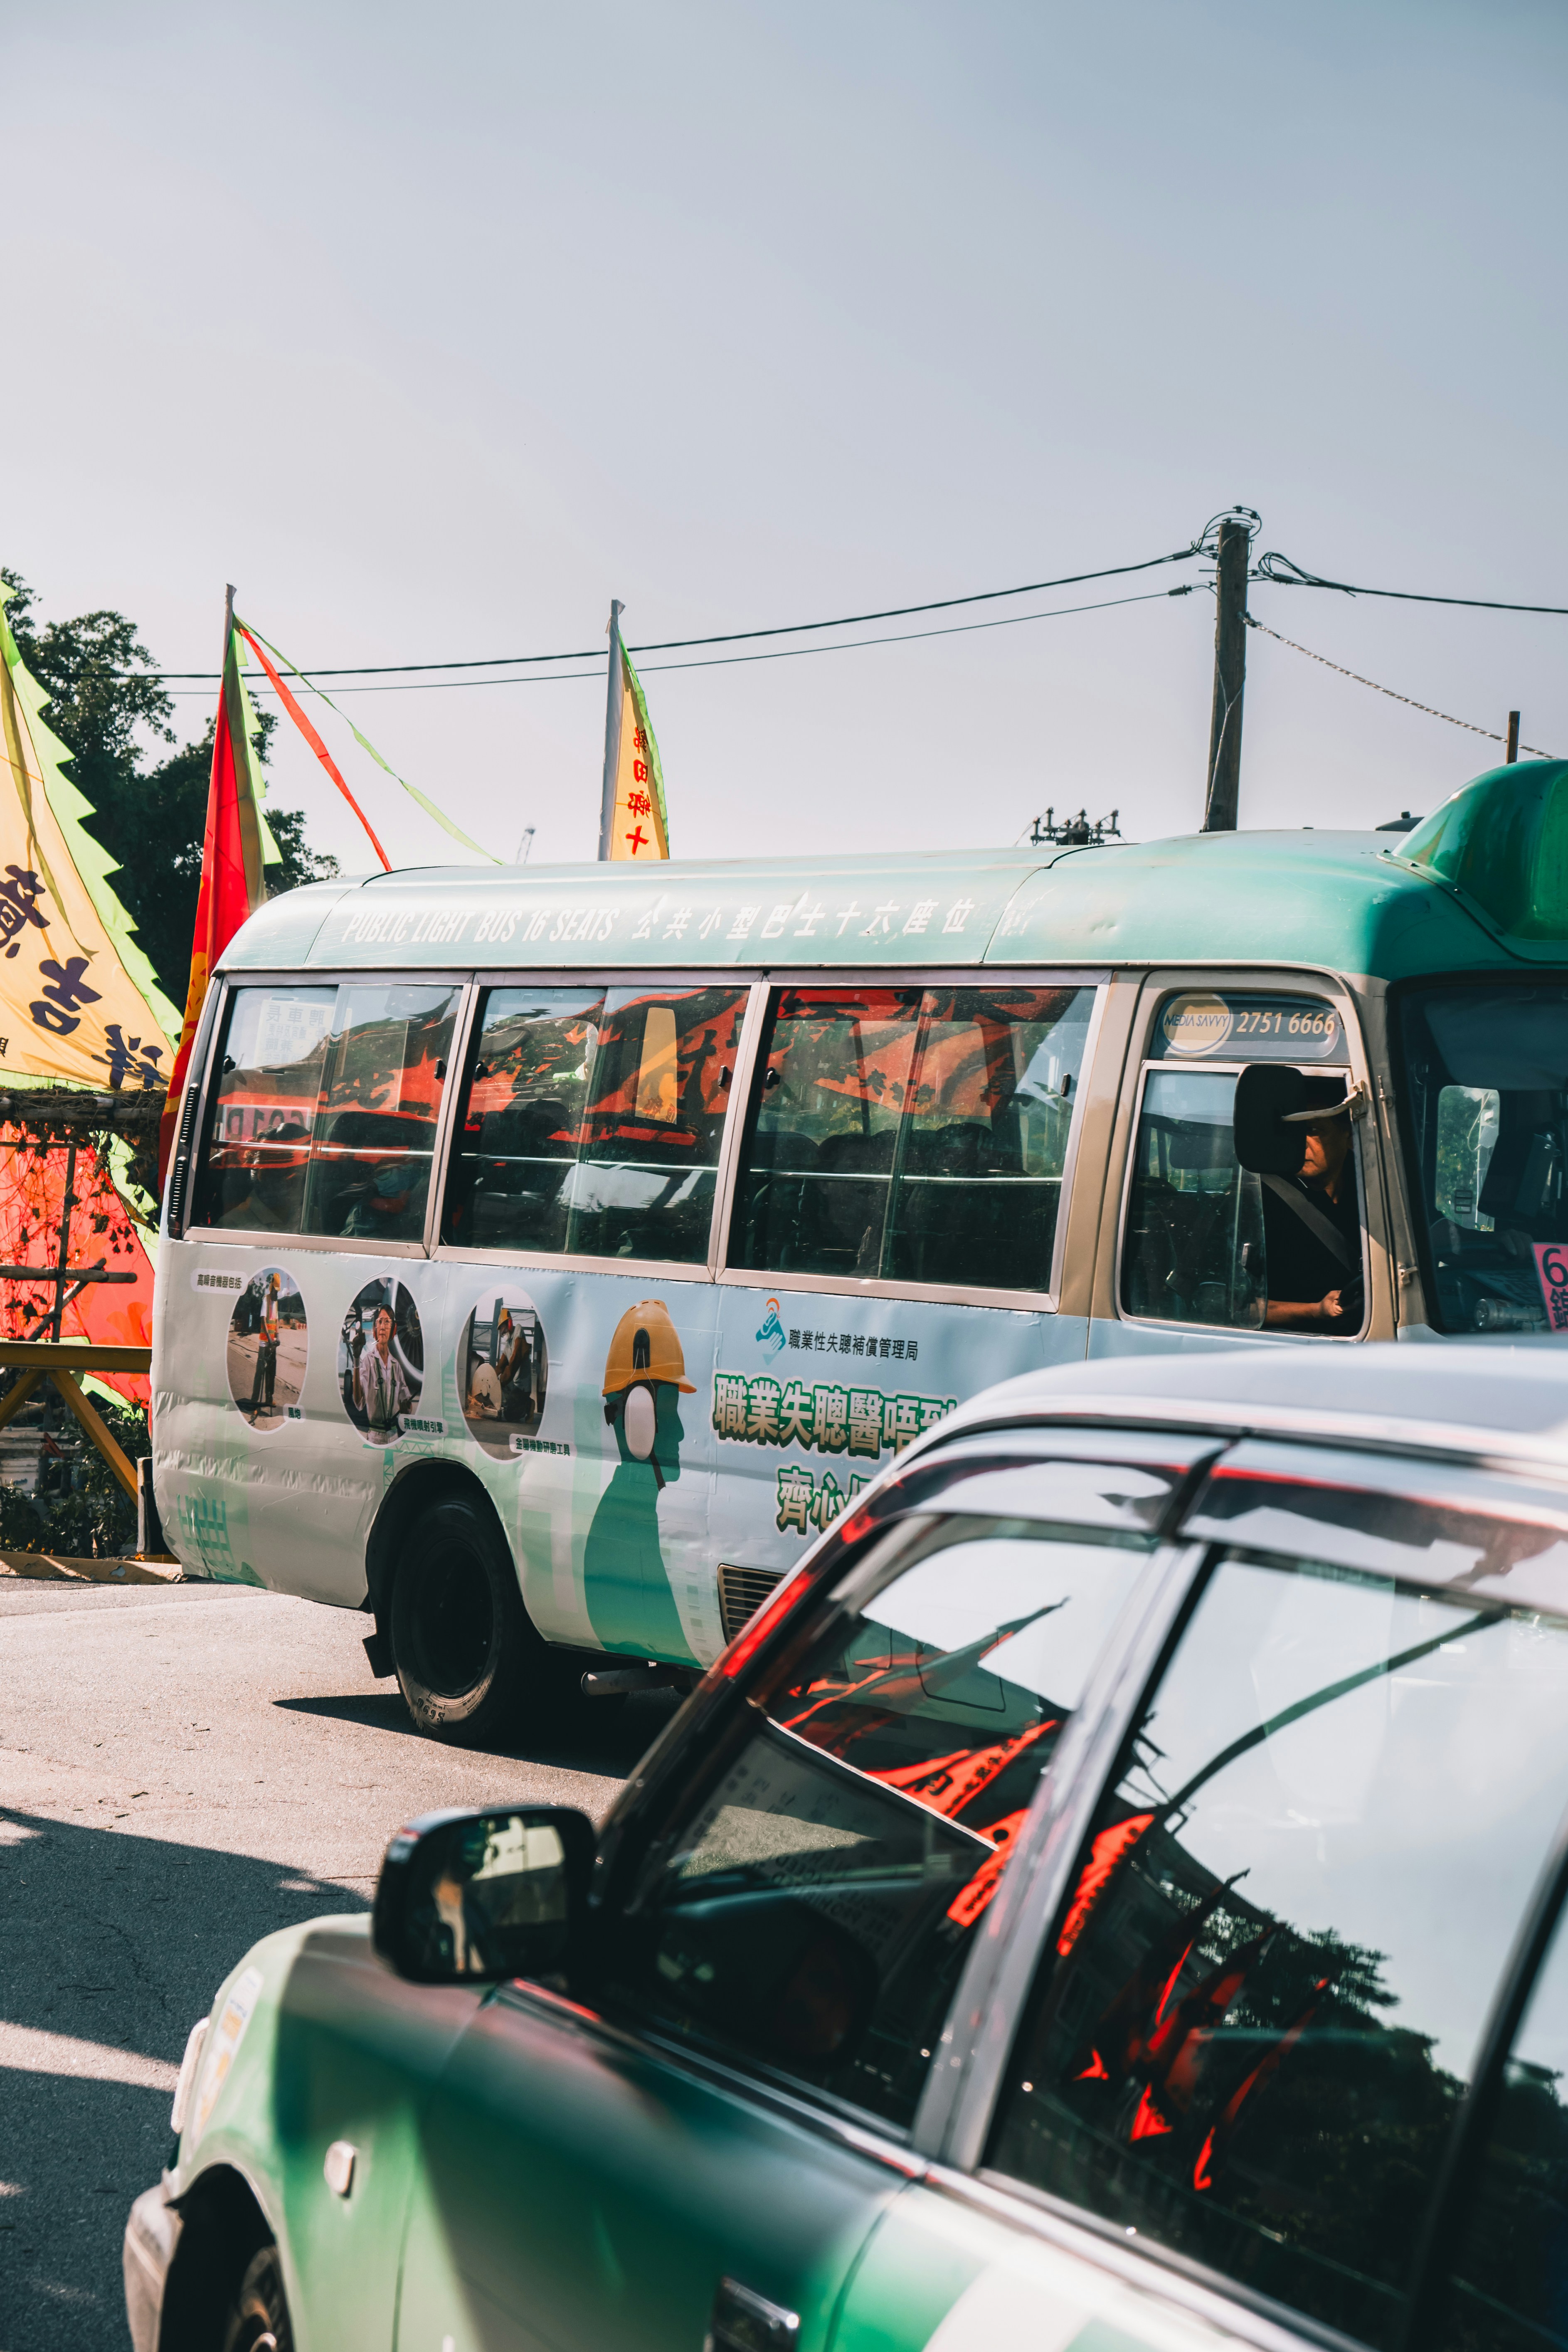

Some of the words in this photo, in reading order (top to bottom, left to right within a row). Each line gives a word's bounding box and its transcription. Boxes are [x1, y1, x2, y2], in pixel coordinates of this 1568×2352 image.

[342, 912, 415, 942] PUBLIC
[411, 911, 476, 942] LIGHT
[473, 910, 523, 942] BUS
[522, 910, 547, 942] 16
[549, 907, 621, 942] SEATS
[631, 898, 975, 940] 公共小型巴士十六座位
[1164, 1014, 1194, 1027] MEDIA
[1196, 1015, 1231, 1028] SAVVY
[1237, 1011, 1282, 1033] 2751
[1288, 1012, 1335, 1035] 6666
[789, 1329, 918, 1361] 職業性失聰補償管理局
[403, 1418, 444, 1434] 飛機噴射引擎
[515, 1437, 571, 1457] 金屬機動研磨工具
[777, 1466, 875, 1536] 齊心
